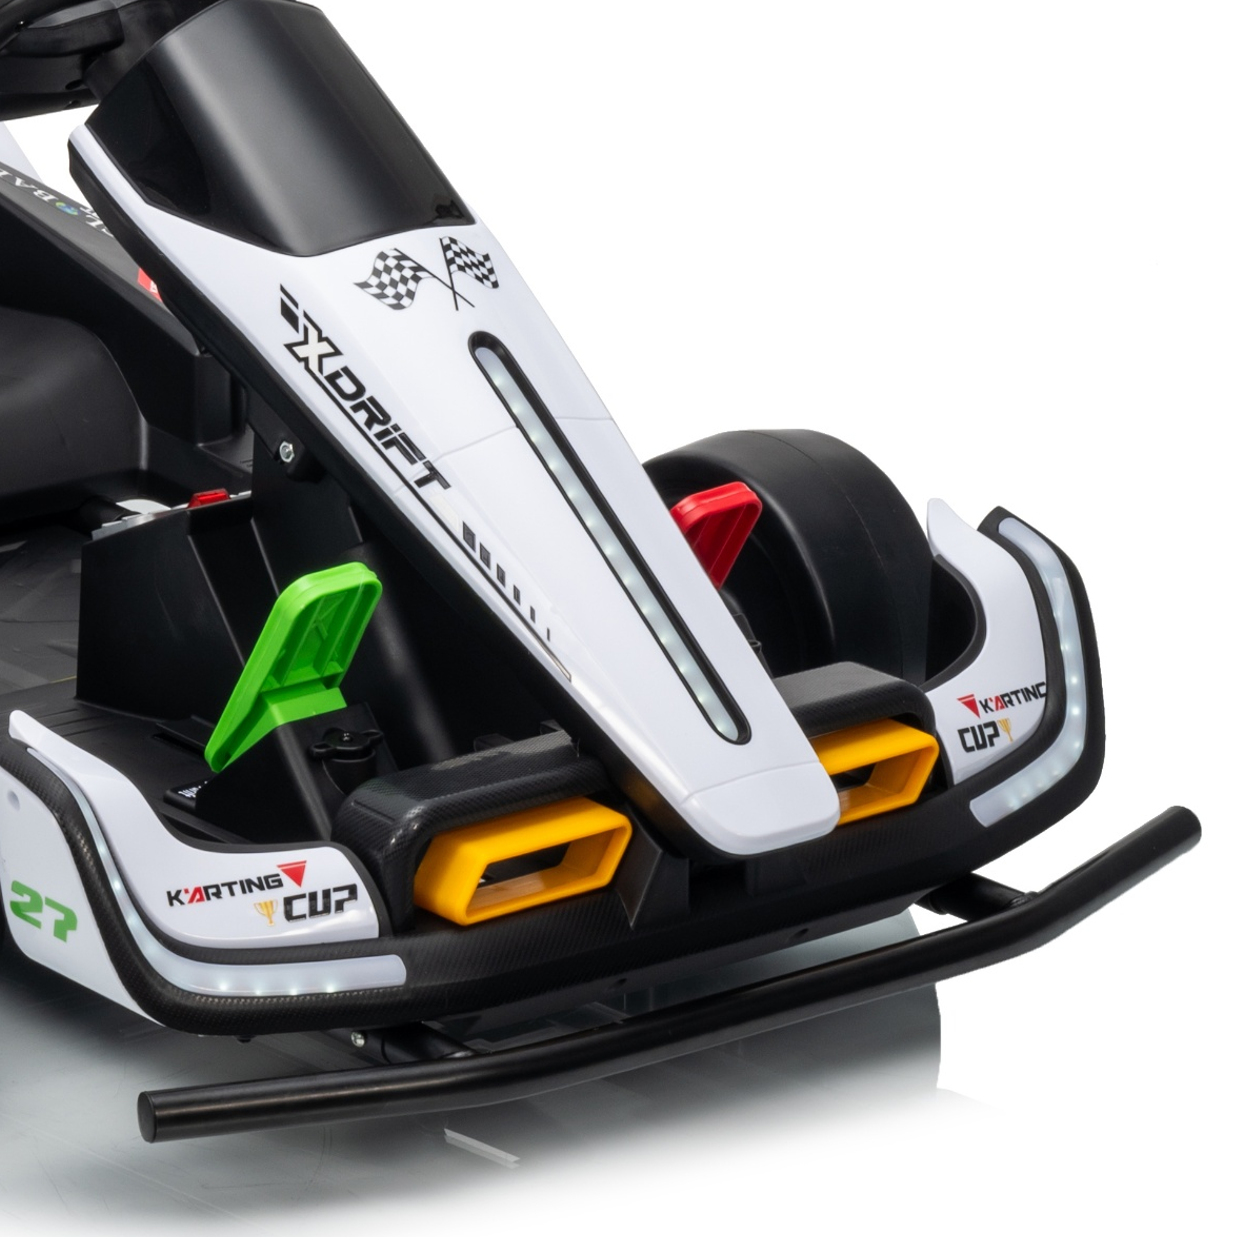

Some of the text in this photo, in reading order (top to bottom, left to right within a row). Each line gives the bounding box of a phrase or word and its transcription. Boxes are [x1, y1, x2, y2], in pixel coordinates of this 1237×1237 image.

[957, 720, 1000, 753] CUP
[9, 879, 77, 943] 27
[283, 883, 358, 923] CUP
